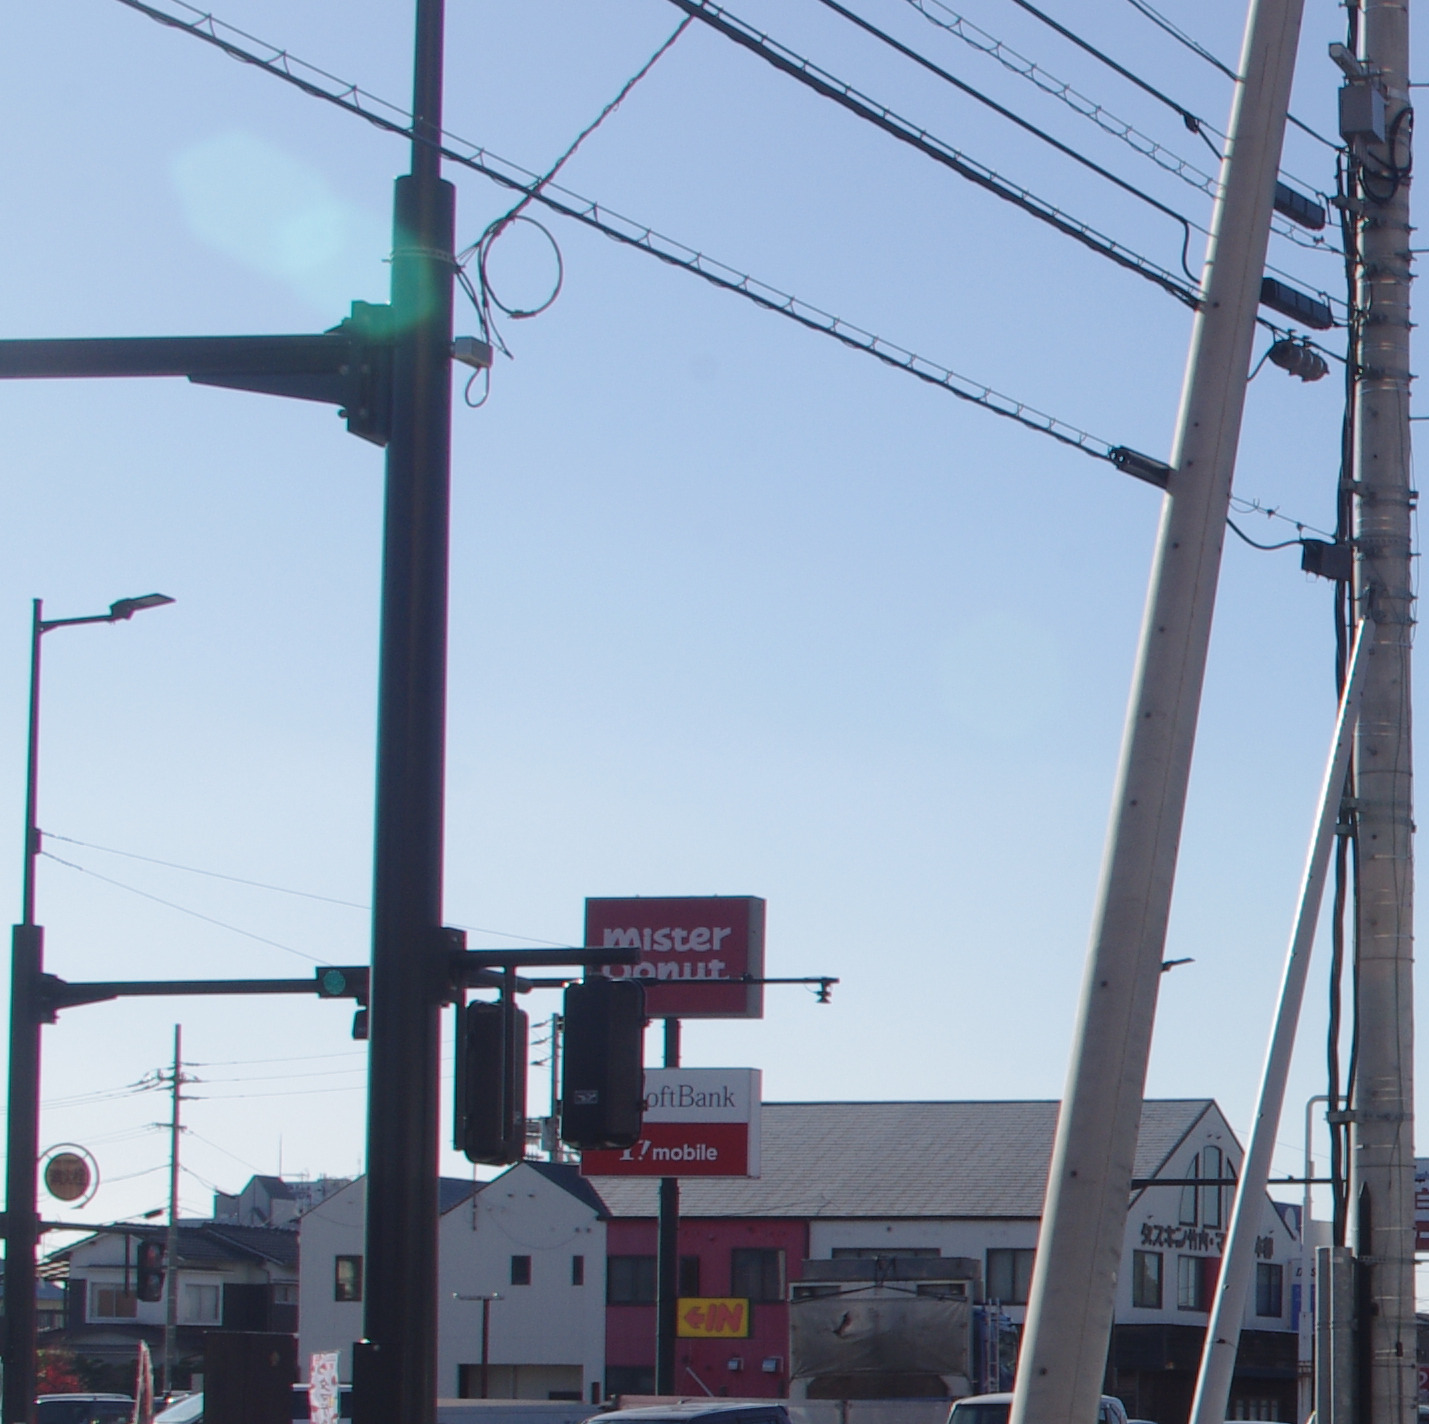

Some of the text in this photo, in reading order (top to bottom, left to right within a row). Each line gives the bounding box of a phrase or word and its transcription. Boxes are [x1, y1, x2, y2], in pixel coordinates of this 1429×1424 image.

[603, 926, 732, 952] mister
[645, 1084, 736, 1109] oftBank
[705, 1302, 744, 1333] IN
